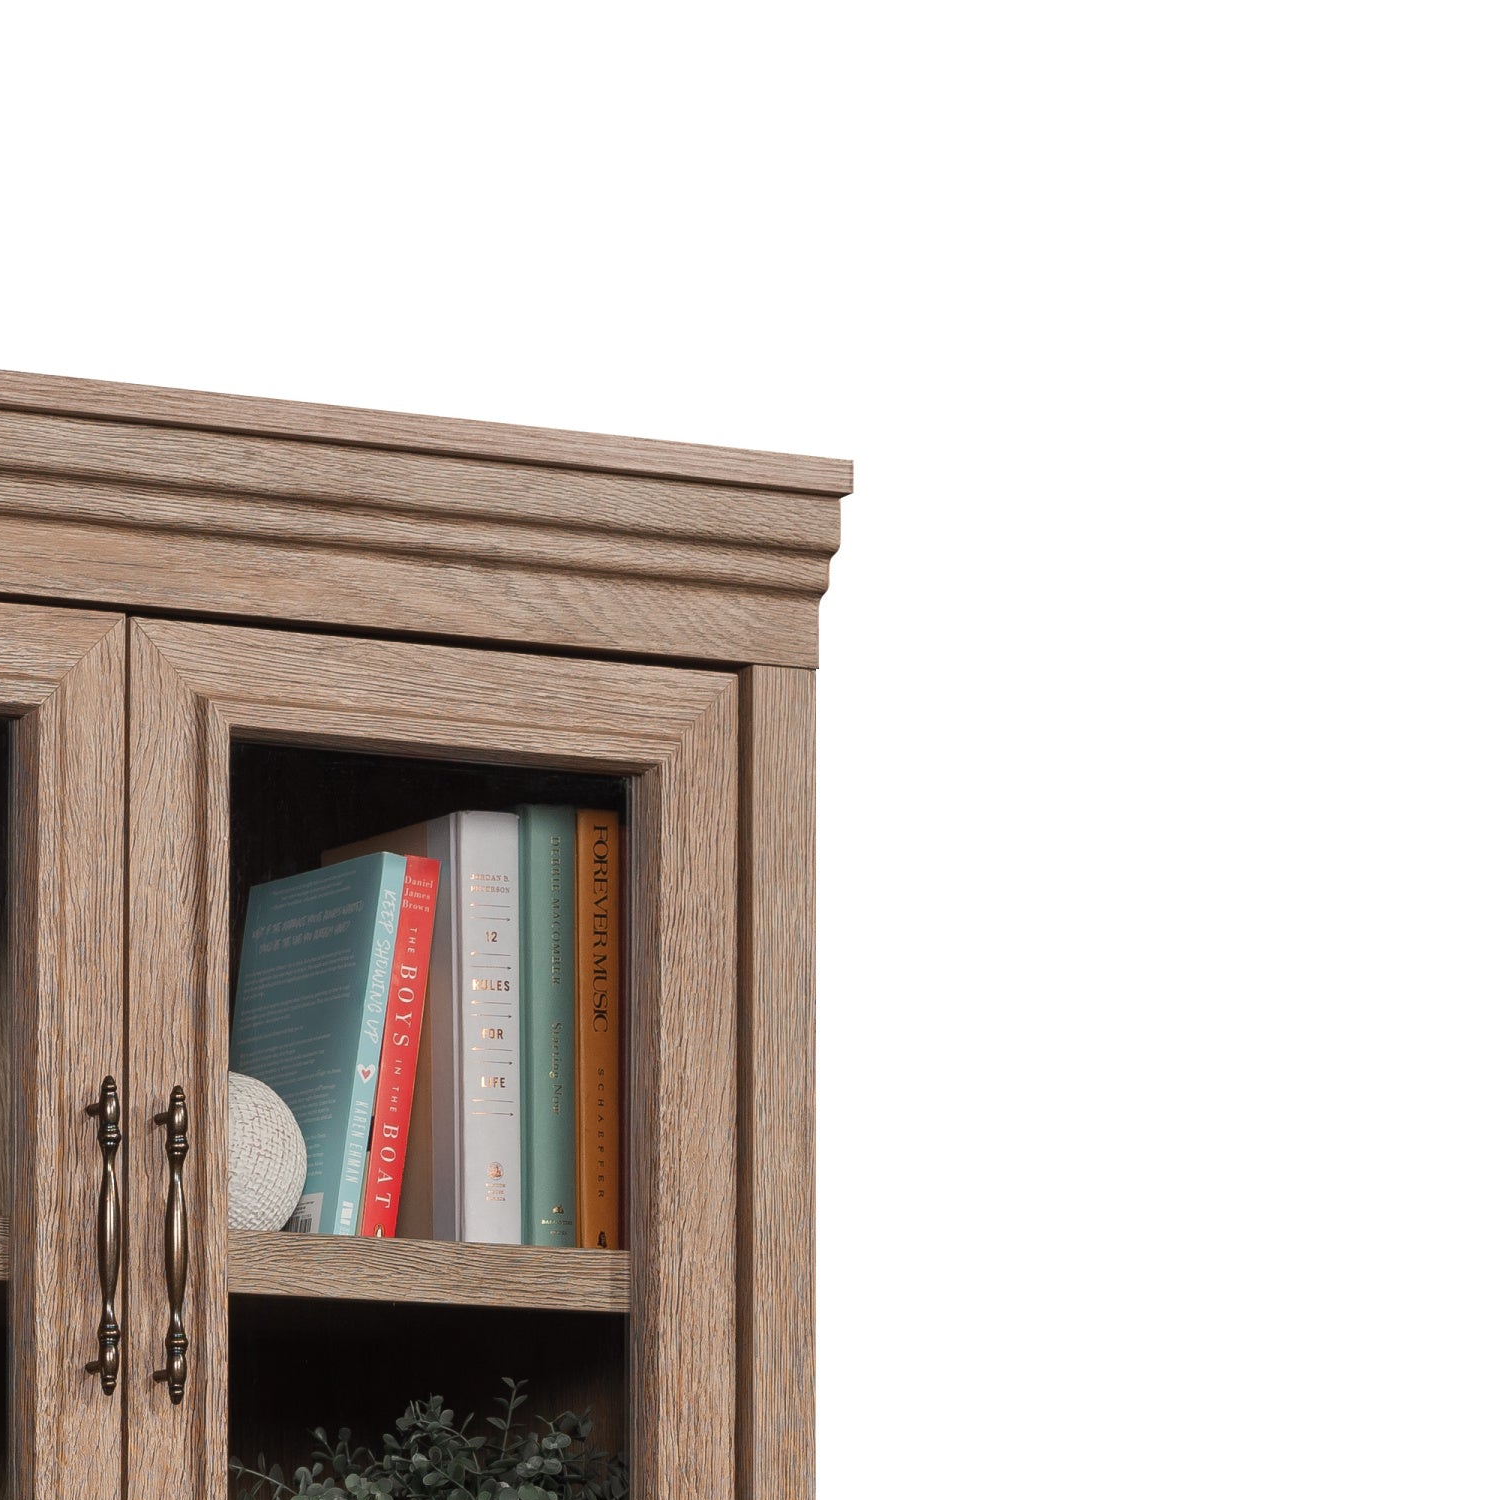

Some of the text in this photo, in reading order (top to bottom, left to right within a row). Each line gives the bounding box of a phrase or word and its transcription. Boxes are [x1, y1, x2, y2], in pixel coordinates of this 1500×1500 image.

[403, 887, 431, 900] James
[404, 875, 434, 889] Daniel
[402, 899, 430, 912] Brown
[485, 931, 498, 943] 12
[551, 898, 561, 985] MACOMBER
[592, 825, 609, 1033] FOREVER MUSIC
[363, 889, 397, 1045] KEEP SHOWING UP
[472, 979, 511, 992] RULES
[482, 1028, 504, 1039] FOR
[374, 927, 418, 1209] THE BOYS IN THE BOAT
[481, 1076, 506, 1088] LIFE
[549, 1022, 563, 1116] Starting Now
[350, 1100, 369, 1139] KAREN
[597, 1068, 605, 1198] SCHAEFFER
[345, 1142, 363, 1184] EHMAN
